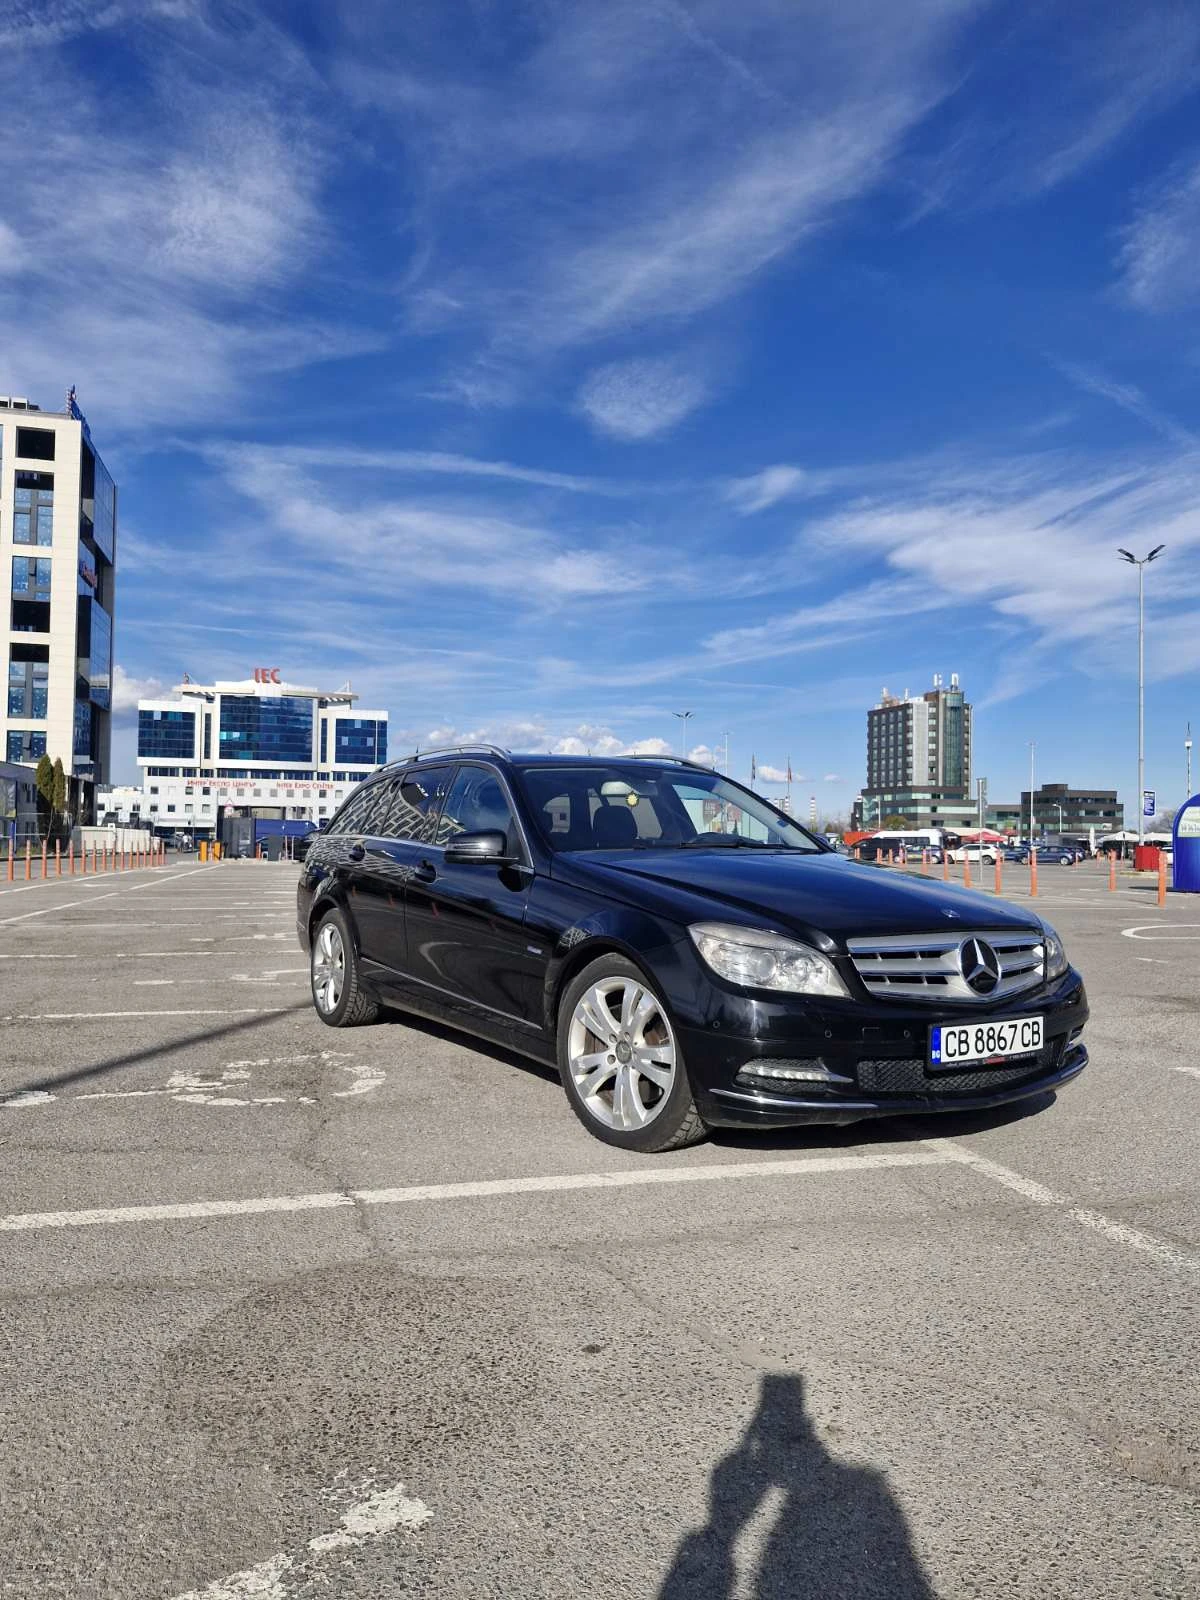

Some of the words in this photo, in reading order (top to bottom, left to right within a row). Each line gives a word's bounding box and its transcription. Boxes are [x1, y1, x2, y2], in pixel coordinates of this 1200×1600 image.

[254, 668, 282, 684] IEC
[945, 1029, 970, 1058] CB
[974, 1023, 1018, 1054] 8867
[1021, 1020, 1041, 1048] CB
[931, 1049, 941, 1060] BG
